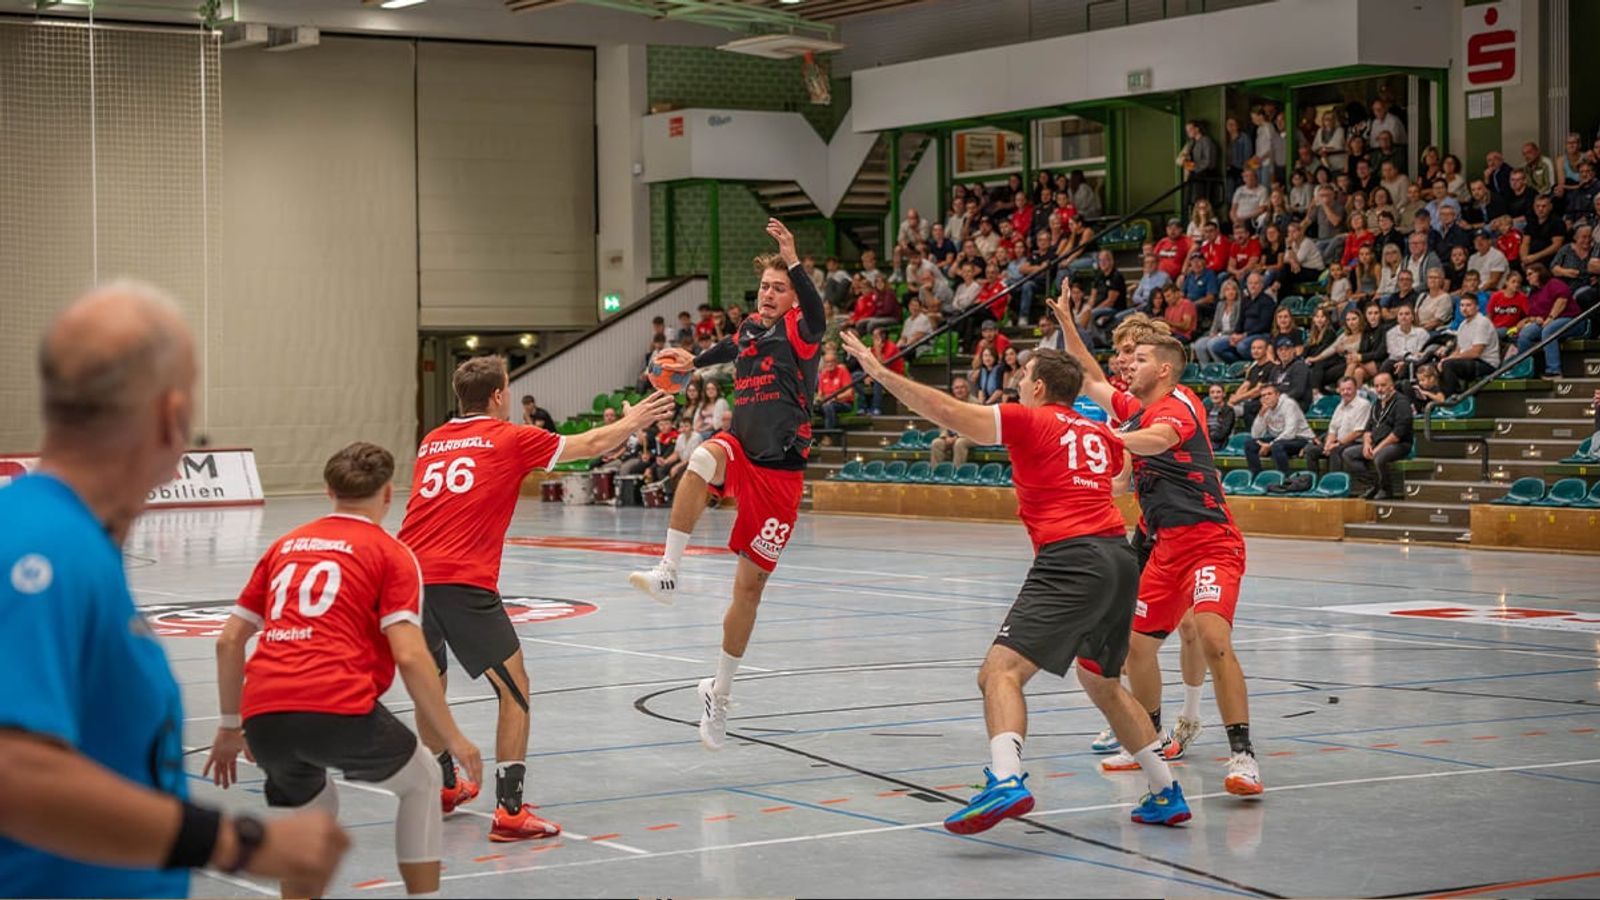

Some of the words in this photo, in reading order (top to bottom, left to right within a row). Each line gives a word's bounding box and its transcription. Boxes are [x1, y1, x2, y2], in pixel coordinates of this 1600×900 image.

[1060, 429, 1108, 474] 19
[146, 483, 225, 501] obilien
[419, 456, 476, 499] 56
[760, 517, 791, 545] 83
[270, 560, 342, 621] 10
[1195, 565, 1217, 587] 15
